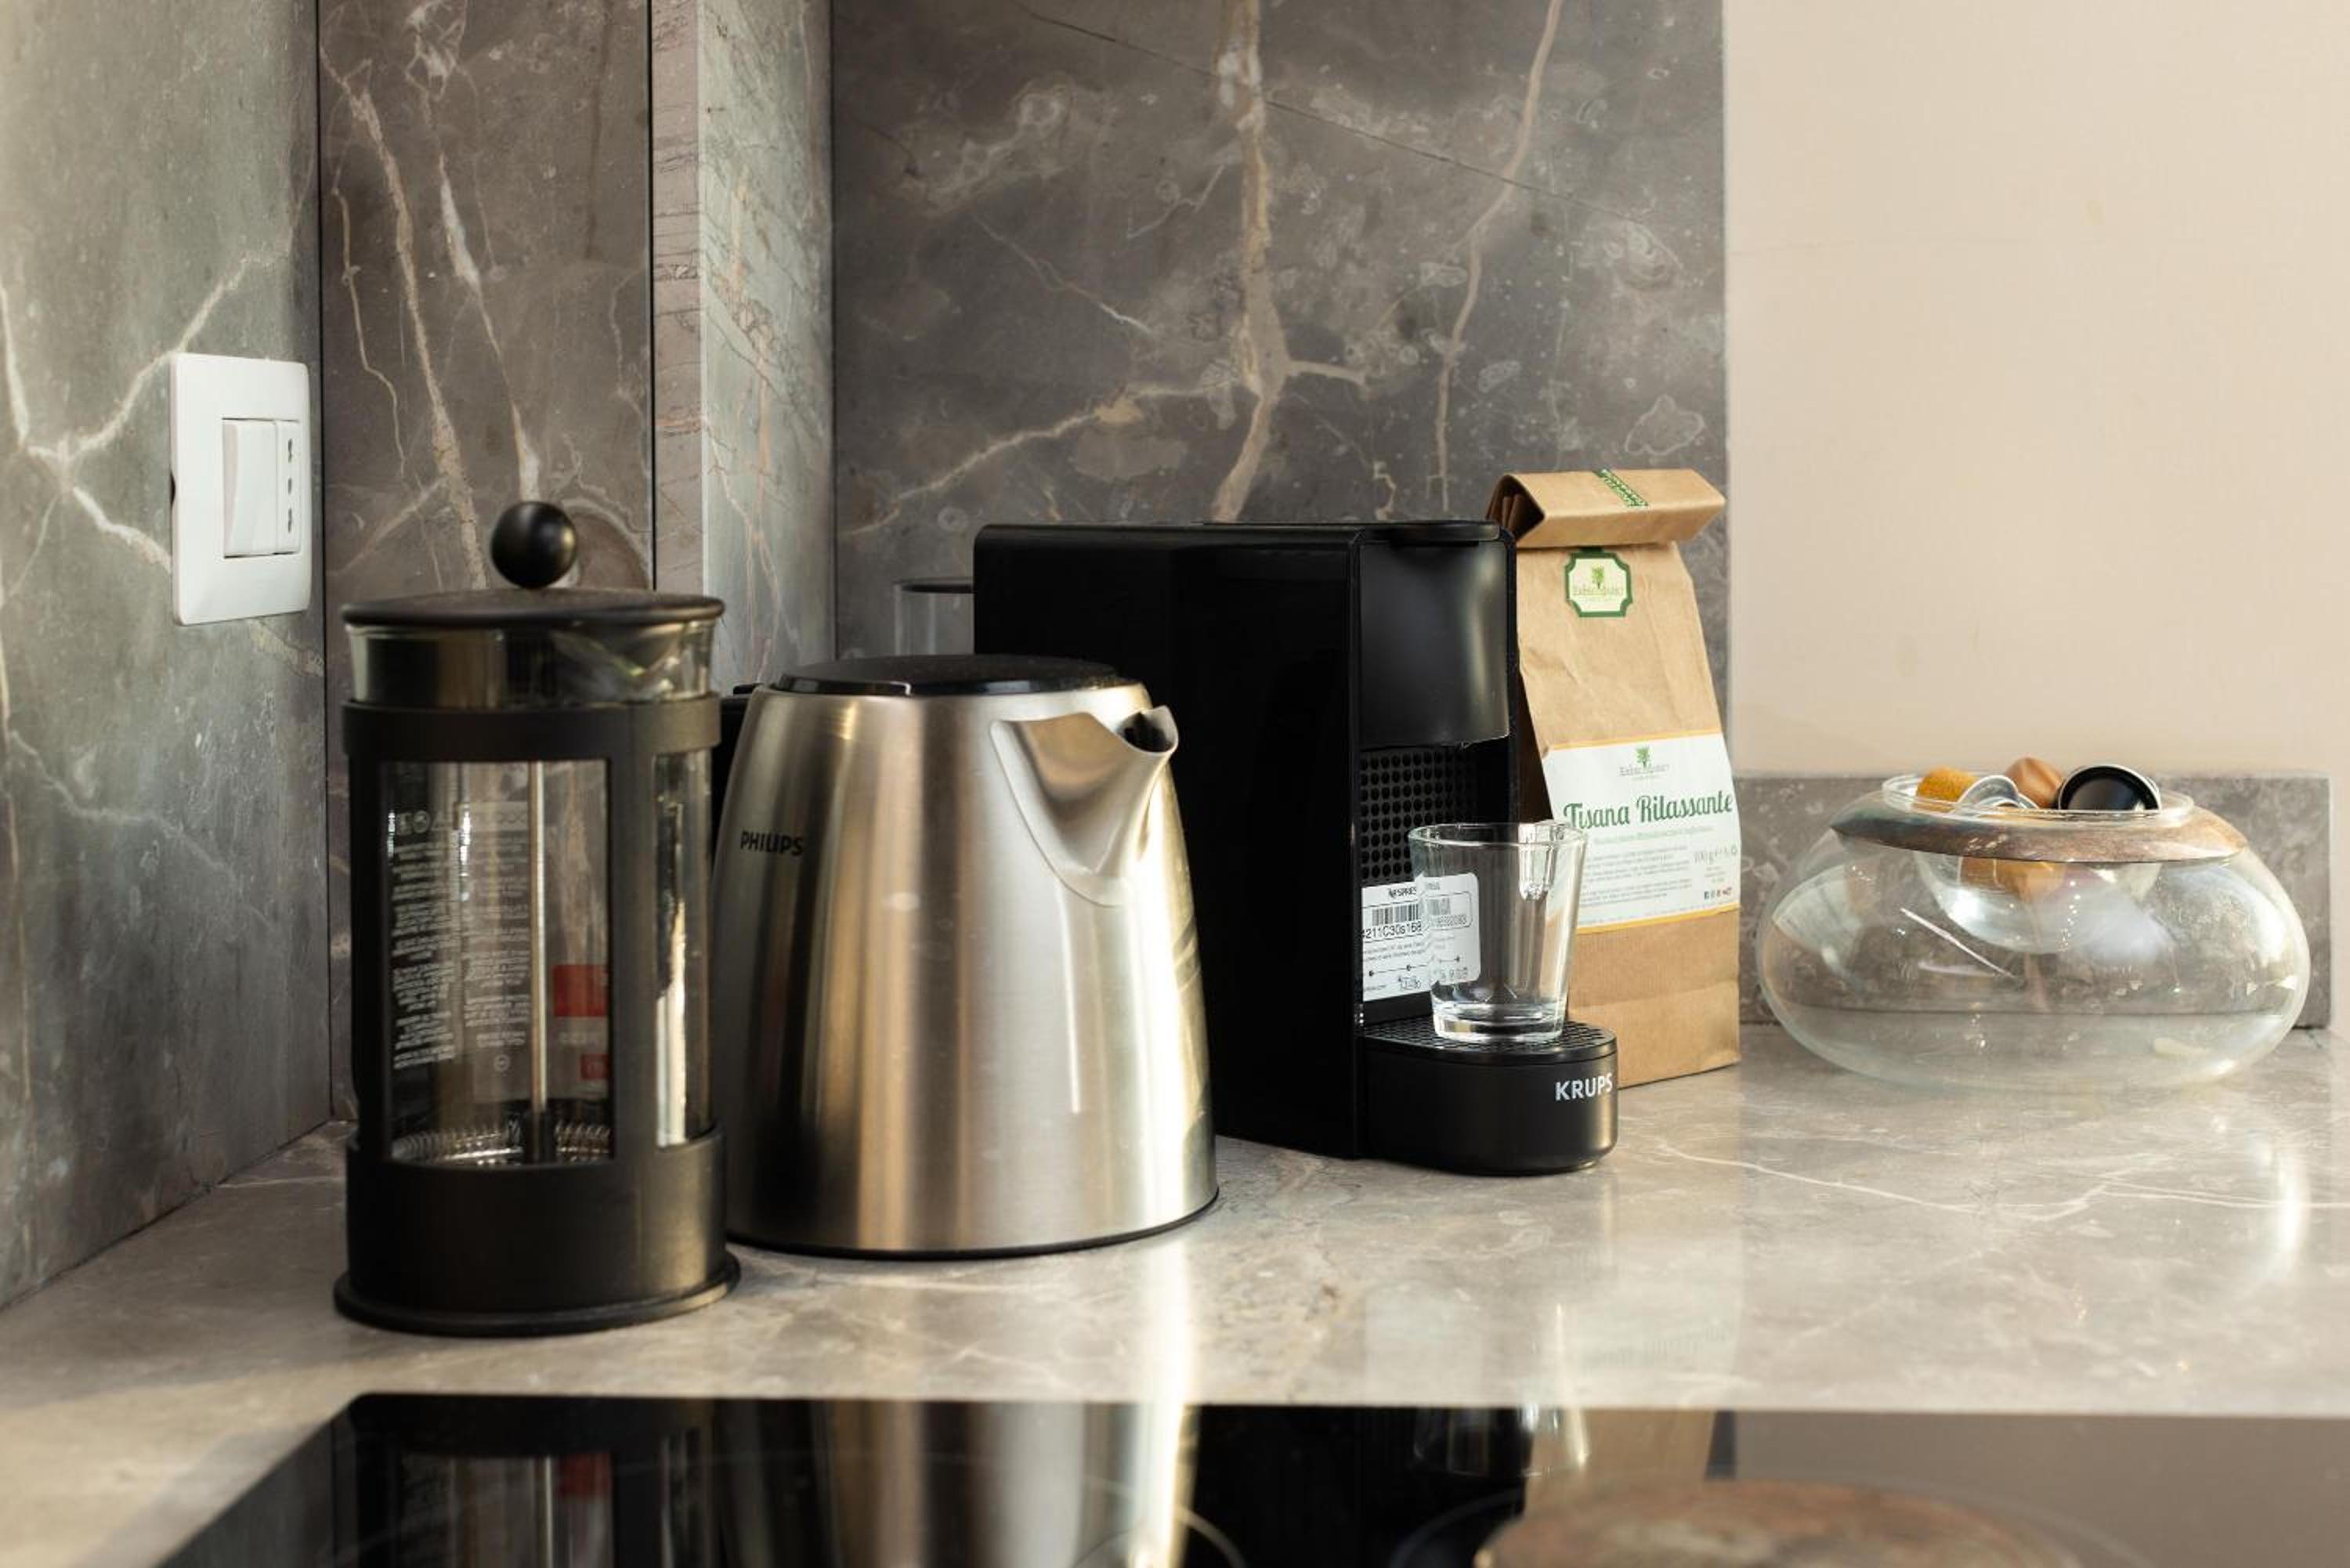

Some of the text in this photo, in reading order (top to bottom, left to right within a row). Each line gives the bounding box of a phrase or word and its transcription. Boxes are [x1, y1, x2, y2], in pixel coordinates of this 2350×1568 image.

[1564, 790, 1733, 829] Tisana Rilassante
[739, 829, 804, 856] PHILIPS
[1555, 1072, 1613, 1101] KRUPS
